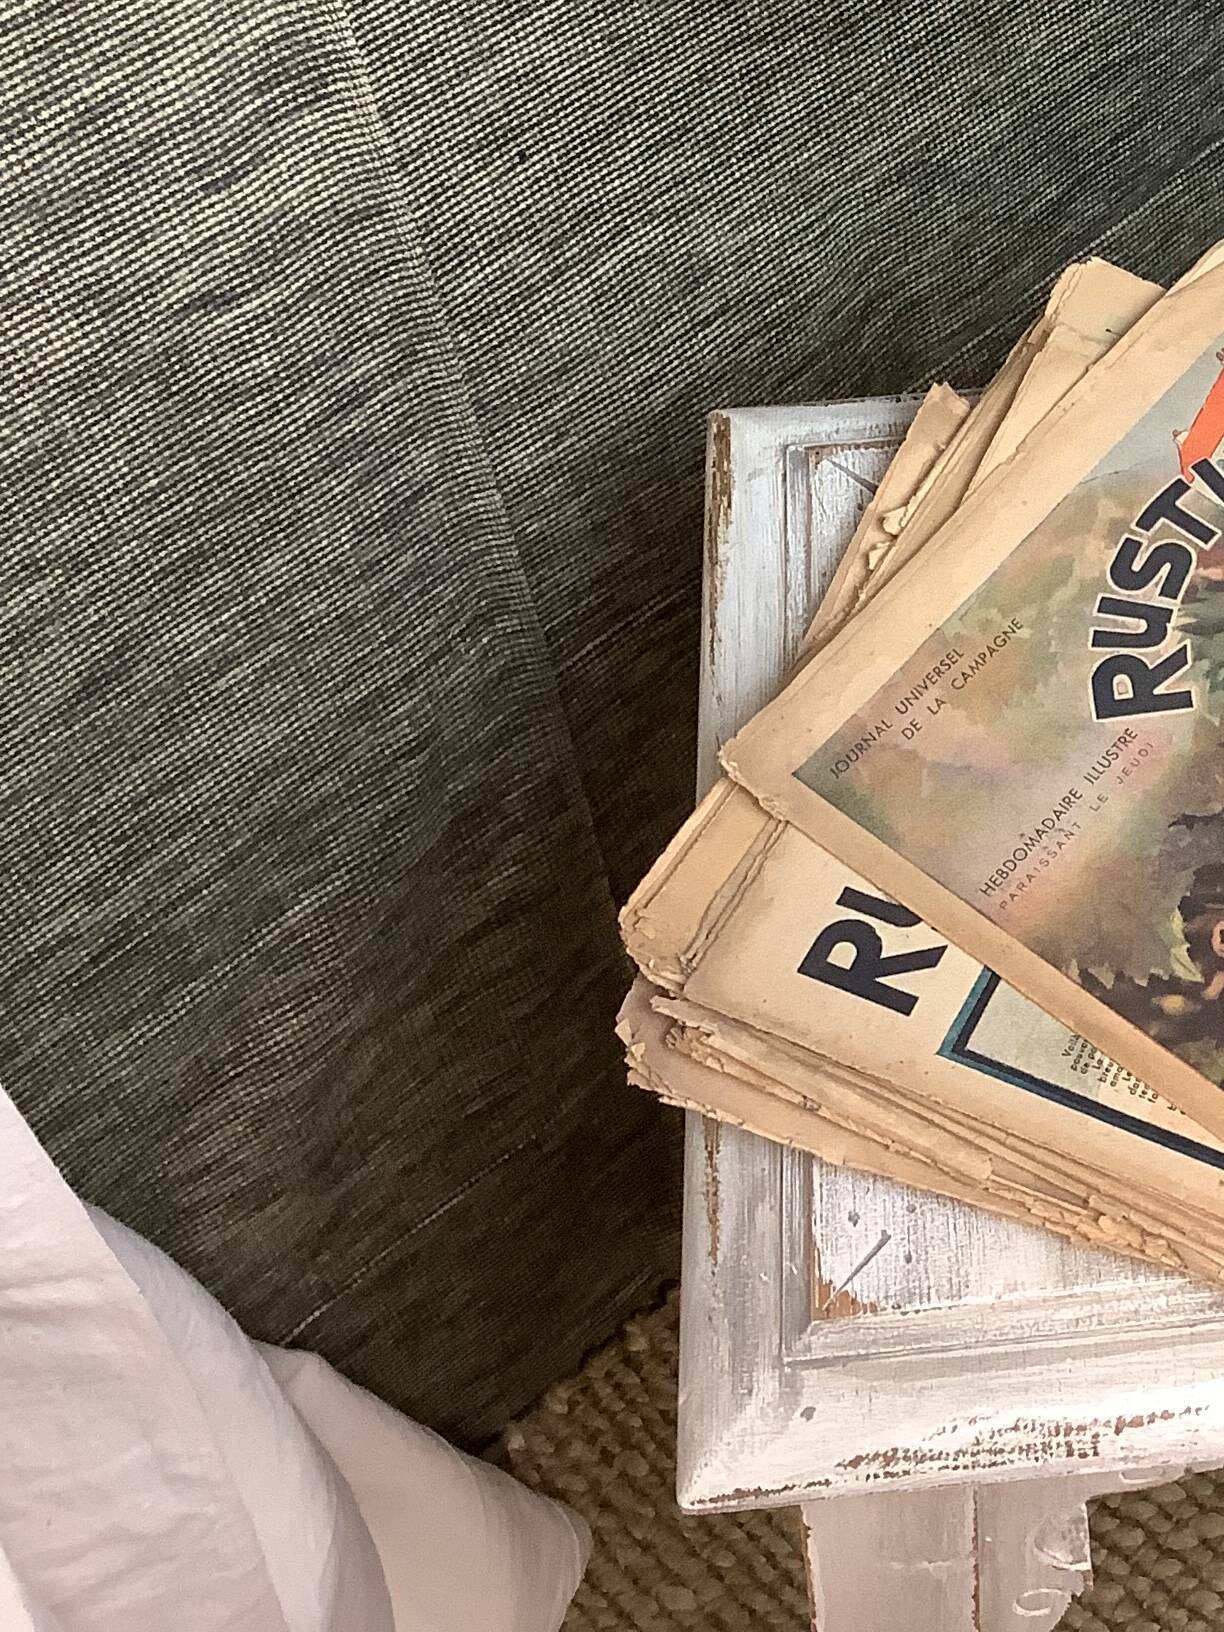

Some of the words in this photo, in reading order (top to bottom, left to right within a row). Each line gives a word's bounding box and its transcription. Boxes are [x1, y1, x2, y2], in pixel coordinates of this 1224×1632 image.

[829, 719, 893, 779] JOURNAL
[894, 648, 965, 715] UNIVERSEL
[901, 719, 923, 740] DE
[926, 697, 948, 715] LA
[951, 618, 1024, 691] CAMPAGNE
[979, 787, 1083, 897] HEBDOMADAIRE
[1000, 822, 1081, 910] PARAISSANT
[1089, 792, 1109, 812] LE
[1116, 742, 1154, 785] JEUDI
